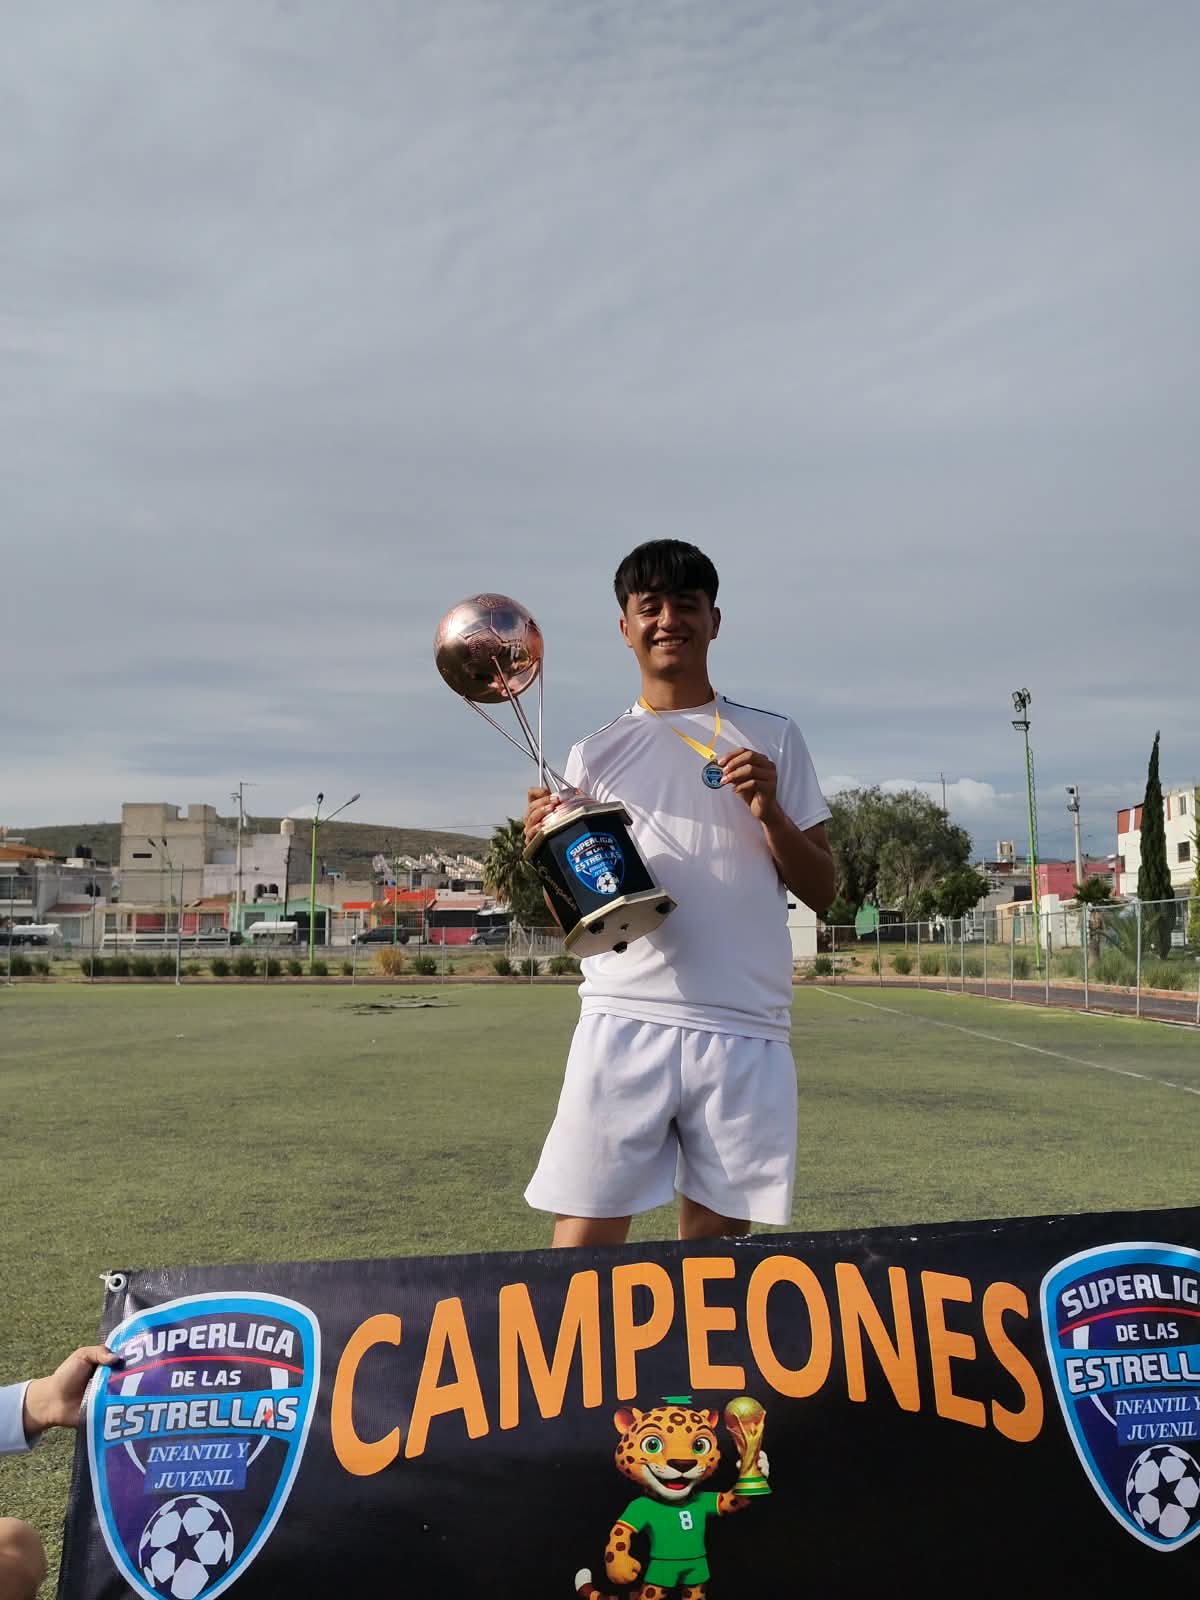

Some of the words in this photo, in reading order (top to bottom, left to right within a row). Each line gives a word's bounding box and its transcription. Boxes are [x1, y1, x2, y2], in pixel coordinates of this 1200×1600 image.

[570, 837, 613, 857] SUPERLIGA
[1061, 1274, 1200, 1318] SUPERLIG
[1115, 1324, 1140, 1342] DE
[1143, 1322, 1179, 1340] LAS
[124, 1322, 294, 1367] SUPERLIGA
[331, 1255, 1044, 1476] CAMPEONES
[170, 1371, 197, 1388] DE
[201, 1369, 242, 1386] LAS
[1115, 1396, 1191, 1416] INFANTIL
[103, 1397, 299, 1441] ESTRELLAS
[1127, 1420, 1197, 1441] JUVENIL
[147, 1443, 233, 1463] INFANTIL
[234, 1442, 251, 1458] Y
[154, 1468, 234, 1489] JUVENIL
[679, 1510, 693, 1530] 8
